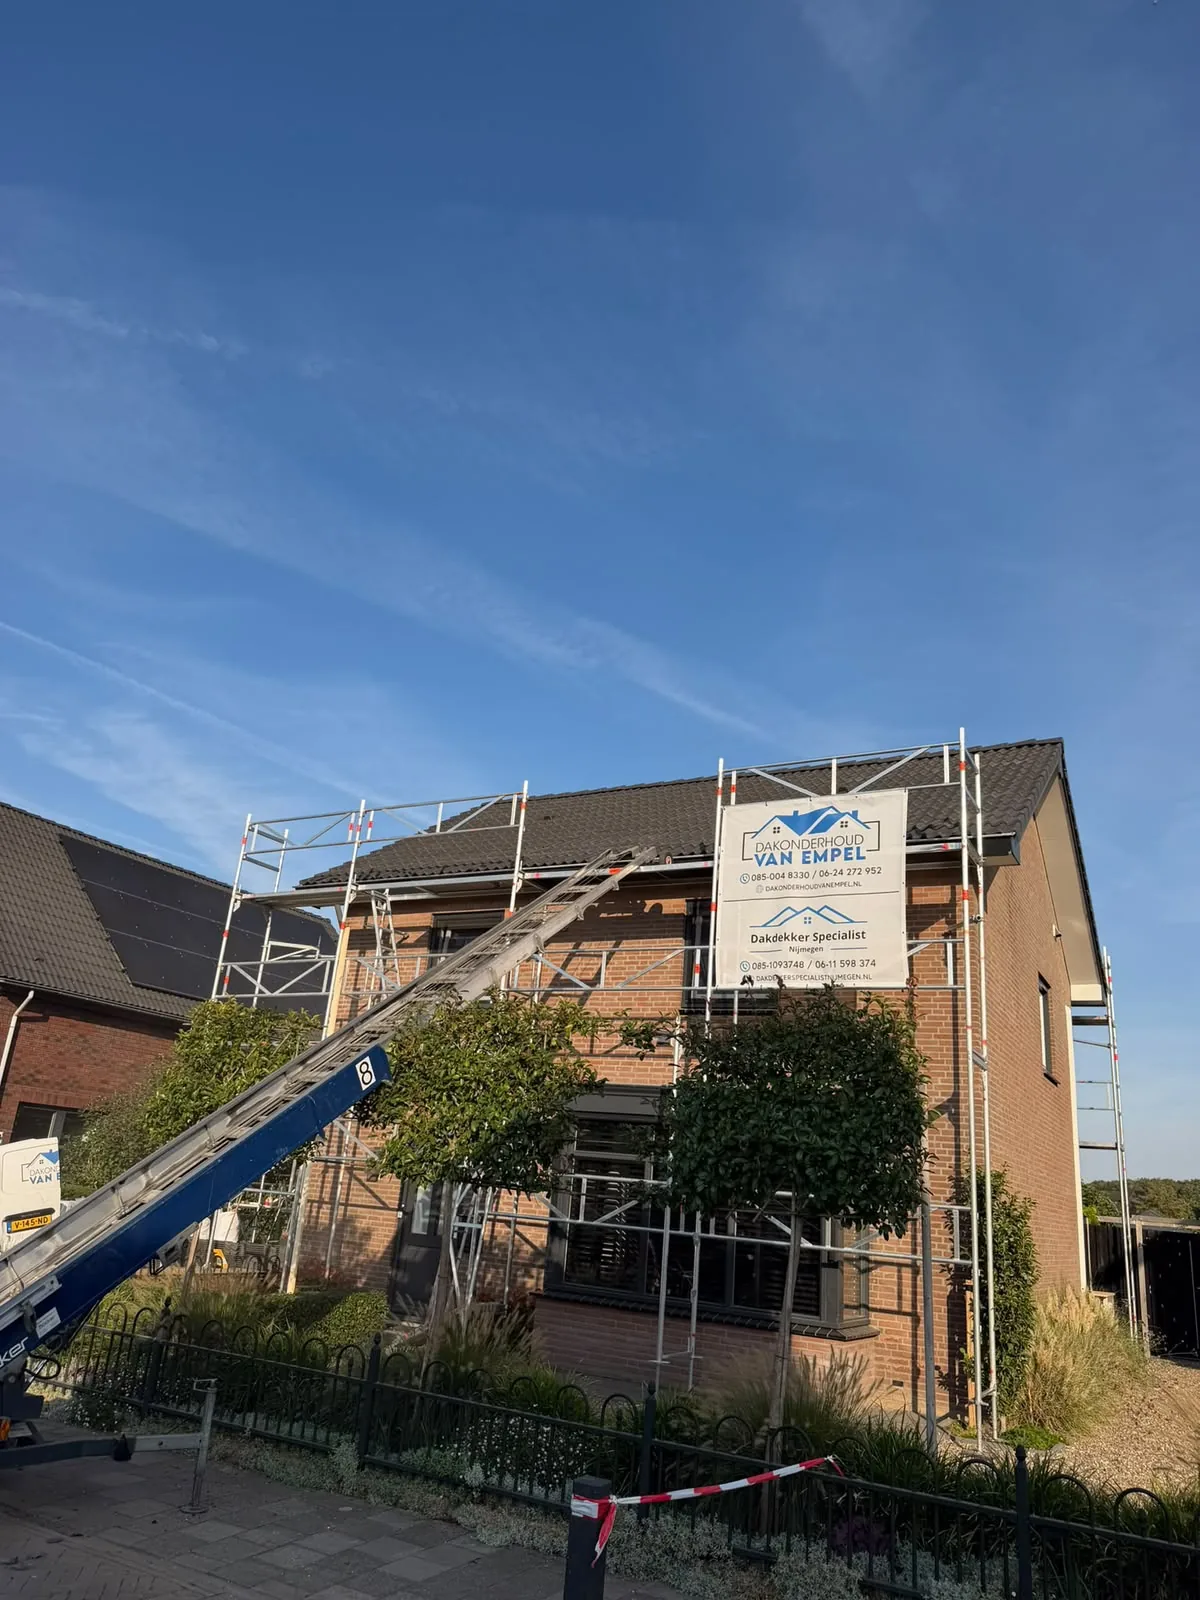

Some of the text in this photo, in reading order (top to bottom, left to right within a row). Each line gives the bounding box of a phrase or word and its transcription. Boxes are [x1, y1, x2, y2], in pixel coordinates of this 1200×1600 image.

[755, 834, 864, 853] DAKONDERHOUD
[754, 846, 866, 867] VAN EMPEL
[751, 872, 786, 882] 085-004
[788, 871, 810, 879] 8330
[819, 868, 844, 878] 06-24
[846, 868, 862, 876] 272
[865, 866, 882, 875] 952
[765, 882, 862, 892] DAKONDERHOUDVANEMPEL.NL
[751, 930, 866, 944] Dakdekker Specialist
[789, 945, 824, 954] Nijmegen
[751, 960, 805, 970] 085-1093748
[815, 960, 837, 969] 06-11
[840, 959, 857, 968] 598
[859, 959, 876, 968] 374
[756, 974, 873, 982] DAKDEERSPECIALISTNIJMEGEN.NL
[360, 1061, 373, 1085] 8
[29, 1174, 52, 1184] VAN
